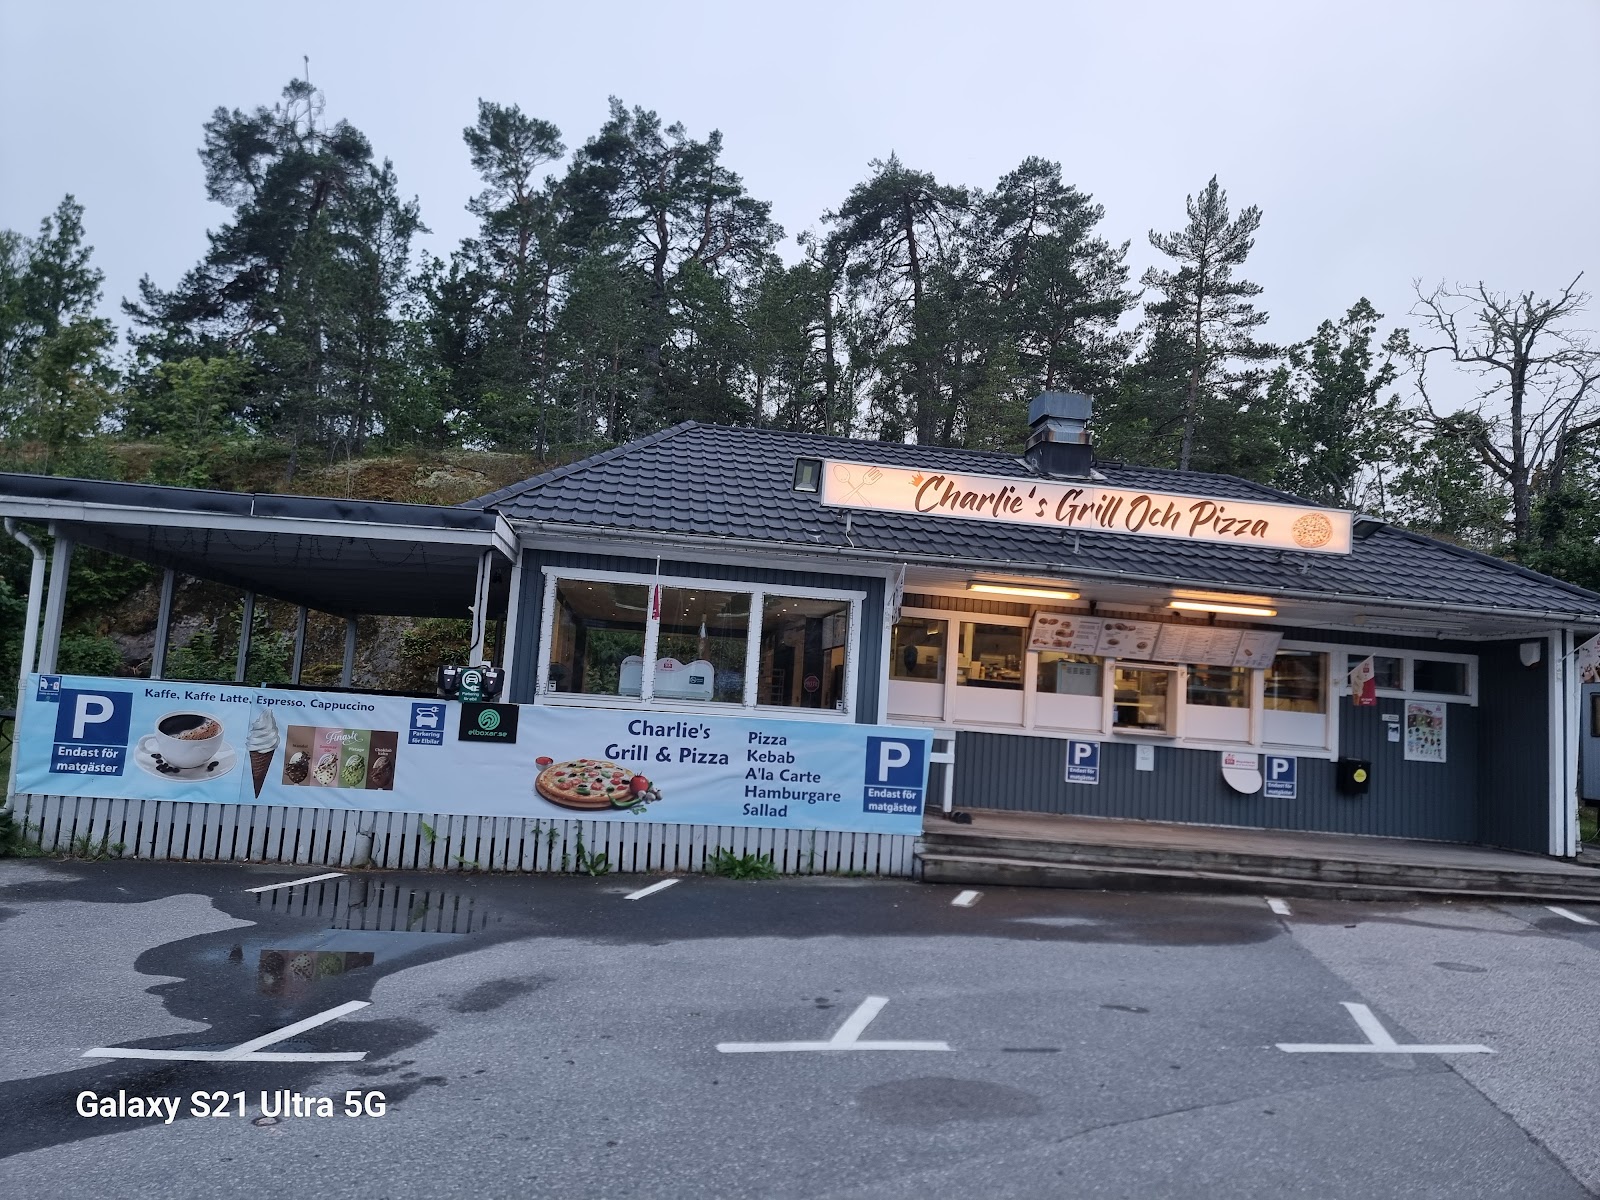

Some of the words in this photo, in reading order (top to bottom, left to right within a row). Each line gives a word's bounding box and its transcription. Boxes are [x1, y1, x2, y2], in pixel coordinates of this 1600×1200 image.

[914, 476, 1047, 517] Charlie's
[1056, 488, 1123, 528] Grill
[1125, 495, 1182, 532] Och
[1188, 500, 1270, 538] Pizza
[144, 688, 180, 700] Kaffe,
[185, 690, 216, 702] Kaffe
[220, 692, 252, 705] Latte,
[256, 695, 306, 709] Espresso,
[310, 699, 375, 712] Cappuccino
[72, 694, 114, 739] P
[413, 731, 440, 739] Parkering
[468, 729, 507, 738] elboxar.se
[628, 719, 711, 739] Charlie's
[748, 731, 788, 746] Pizza
[58, 746, 99, 758] Endast
[101, 748, 118, 759] för
[604, 743, 649, 761] Grill
[655, 746, 672, 762] &
[679, 747, 729, 765] Pizza
[747, 749, 796, 765] Kebab
[1074, 743, 1092, 765] P
[56, 762, 118, 774] matgäster
[878, 741, 911, 782] P
[1272, 758, 1289, 780] P
[745, 767, 774, 781] A'la
[779, 769, 821, 783] Carte
[744, 785, 842, 804] Hamburgare
[868, 788, 900, 799] Endast
[902, 790, 917, 800] för
[742, 803, 788, 817] Sallad
[868, 803, 917, 814] matgäster
